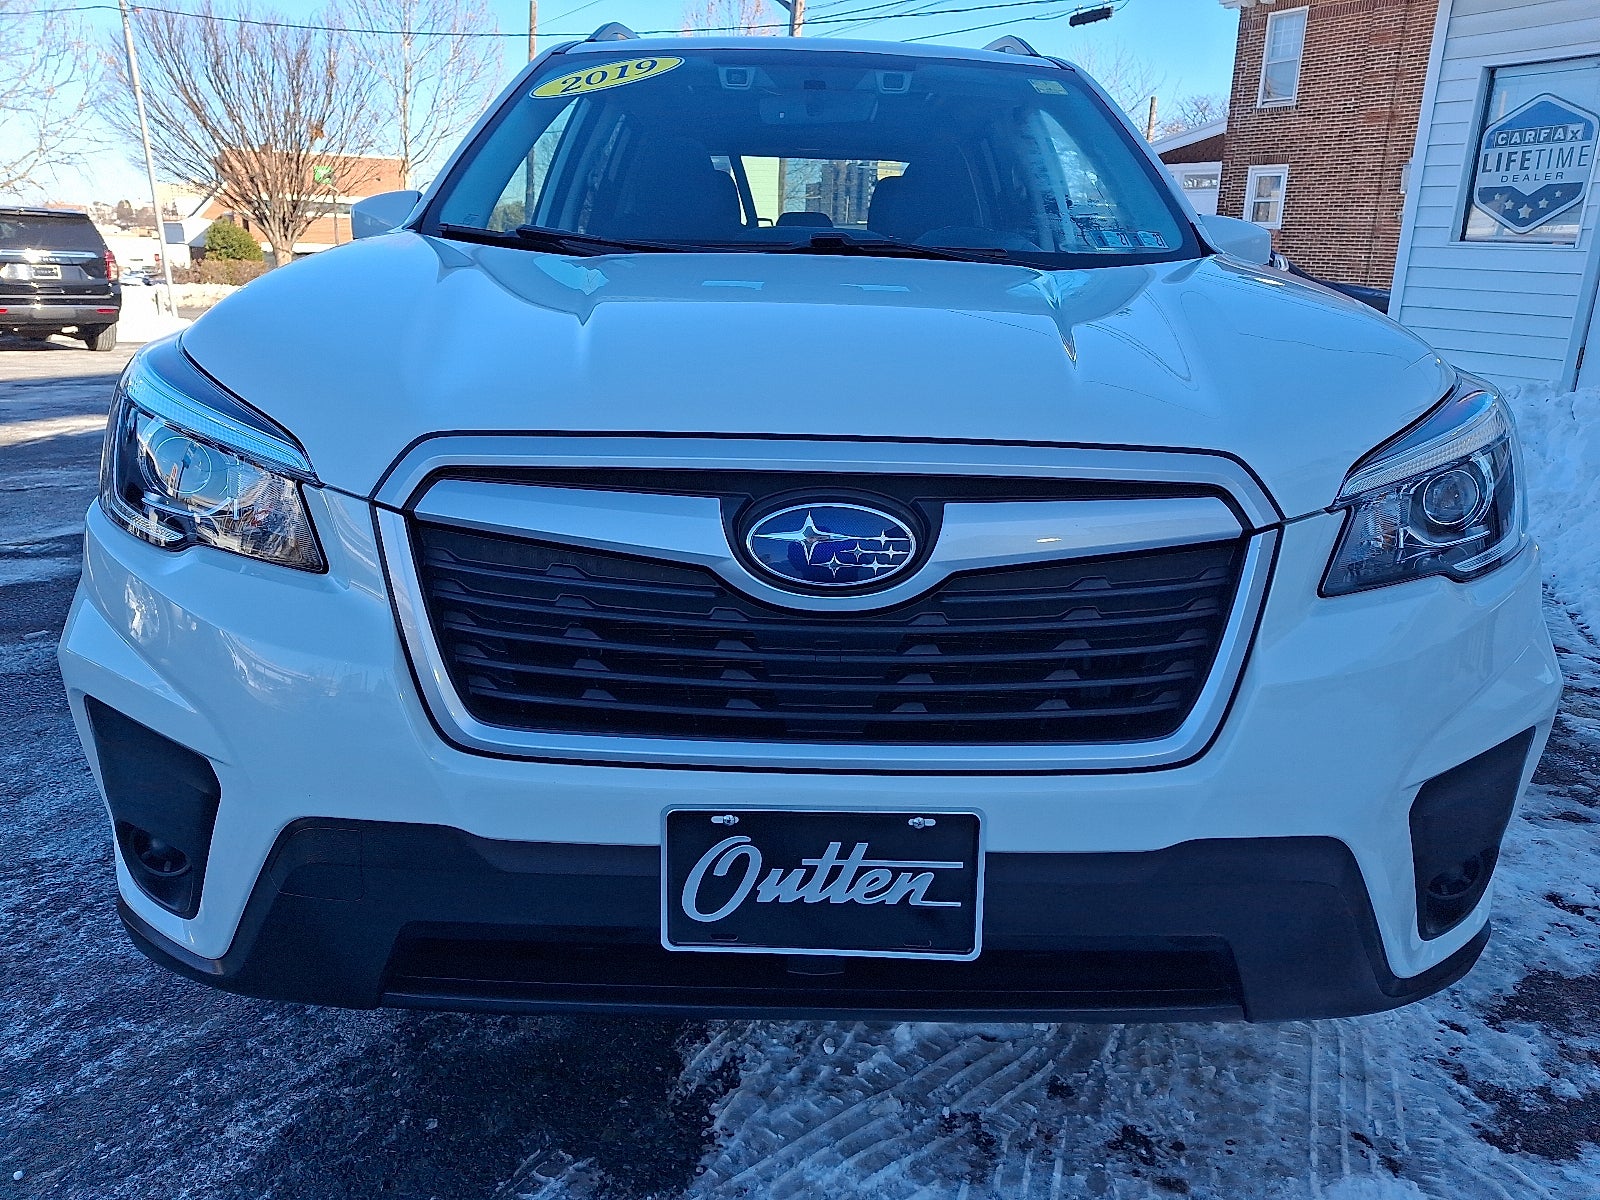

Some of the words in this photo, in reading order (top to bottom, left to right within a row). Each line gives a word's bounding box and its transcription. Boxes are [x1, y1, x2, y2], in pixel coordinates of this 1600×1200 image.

[560, 59, 658, 93] 2019
[1496, 126, 1583, 147] CARFAX
[1481, 145, 1591, 173] LIFETIME
[1500, 171, 1564, 183] DEALER
[681, 835, 963, 923] Outten
